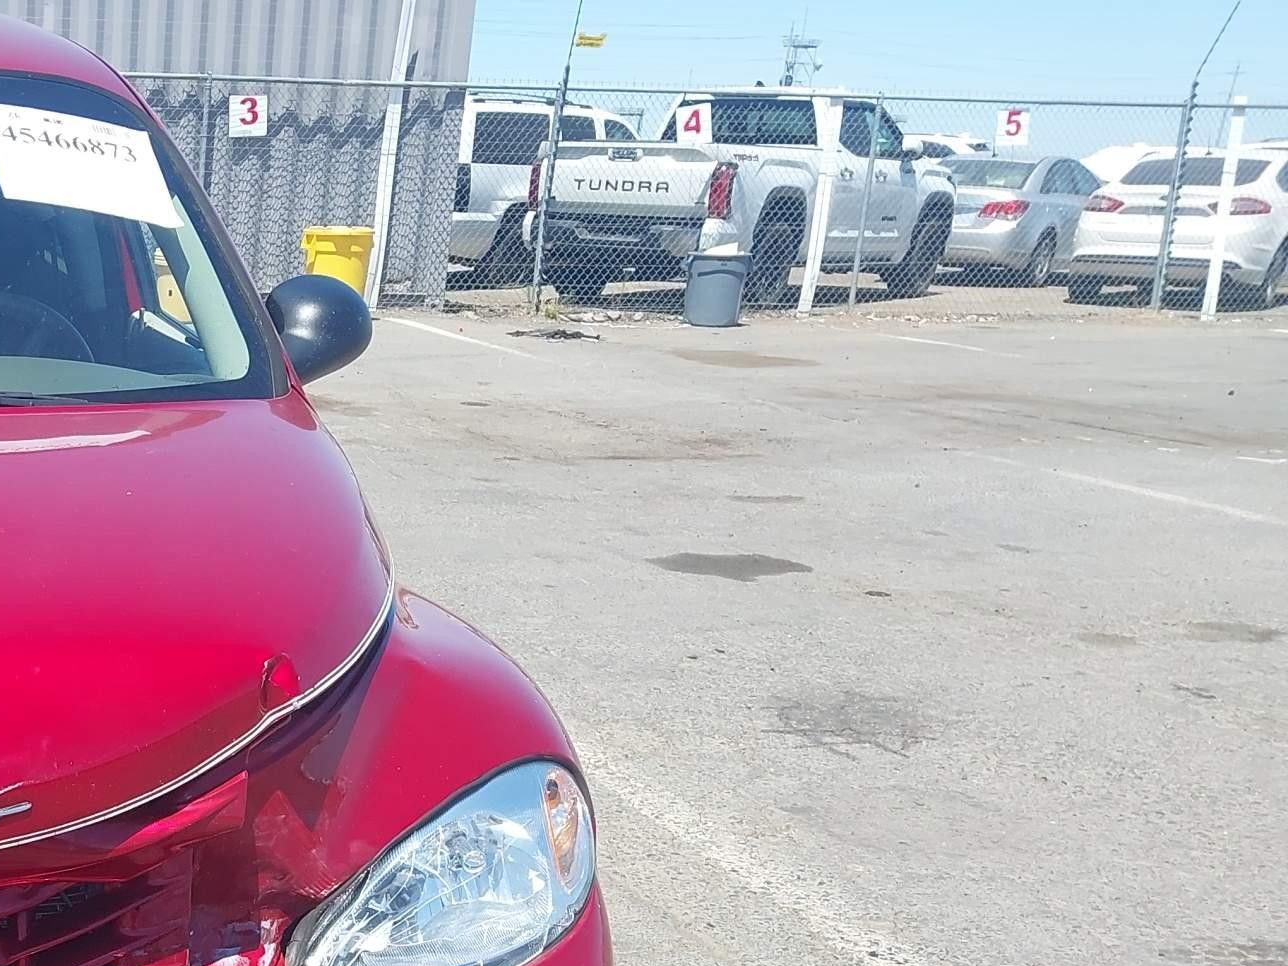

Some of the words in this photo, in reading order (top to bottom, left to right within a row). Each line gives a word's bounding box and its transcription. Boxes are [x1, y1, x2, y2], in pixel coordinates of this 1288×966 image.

[238, 97, 259, 126] 3
[683, 109, 701, 134] 4
[1004, 110, 1022, 136] 5
[1, 125, 138, 163] 45466873
[573, 178, 670, 193] TUNDRA
